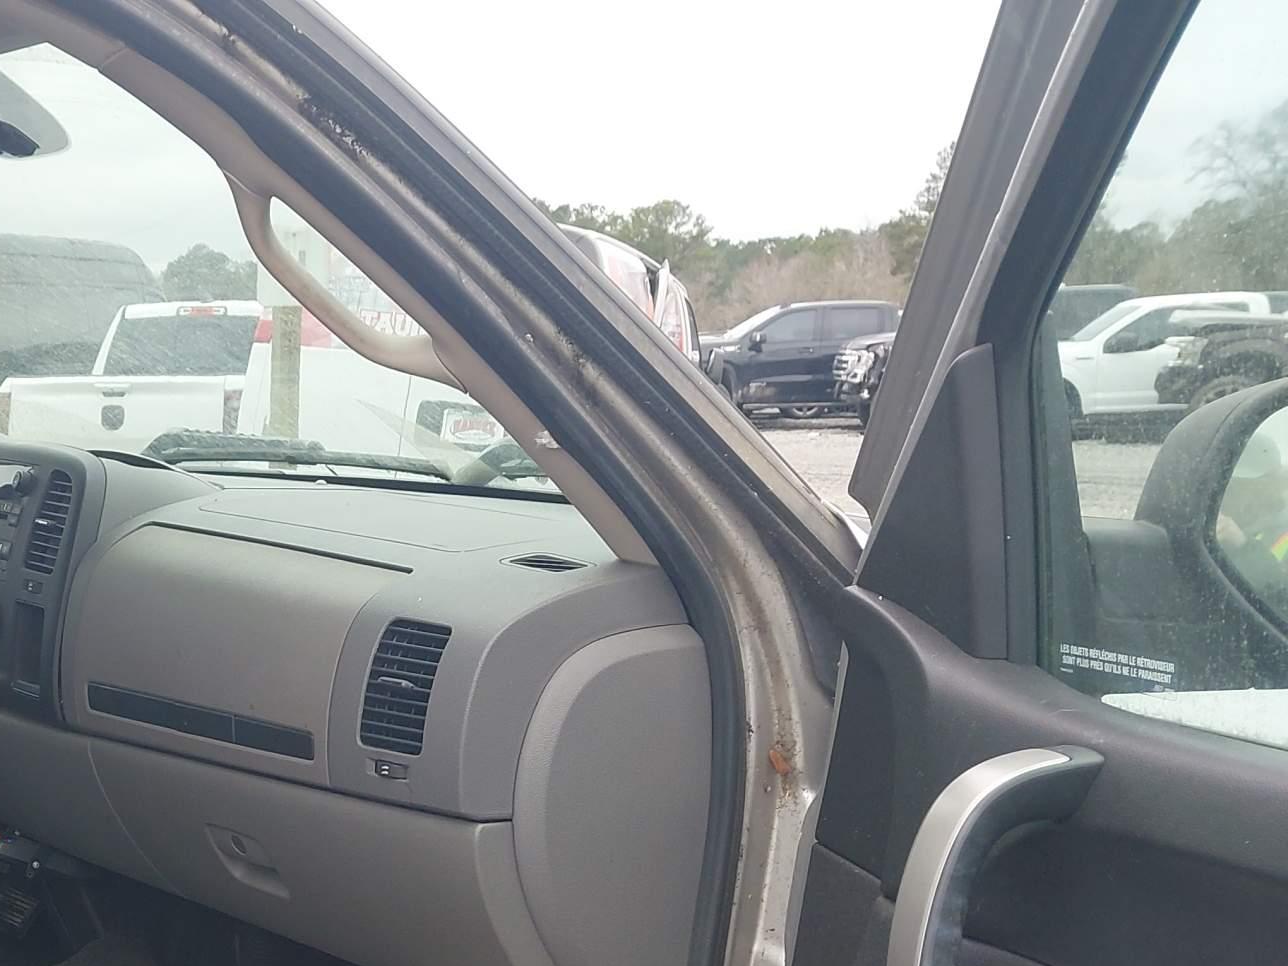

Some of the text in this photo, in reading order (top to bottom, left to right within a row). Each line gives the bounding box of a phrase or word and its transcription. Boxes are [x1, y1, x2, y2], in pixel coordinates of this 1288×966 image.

[1060, 643, 1070, 654] LES
[1070, 645, 1089, 657] OBJETS
[1117, 654, 1129, 664] PAR
[1129, 655, 1137, 666] LE
[1122, 666, 1130, 676] NE
[1130, 668, 1138, 678] LE
